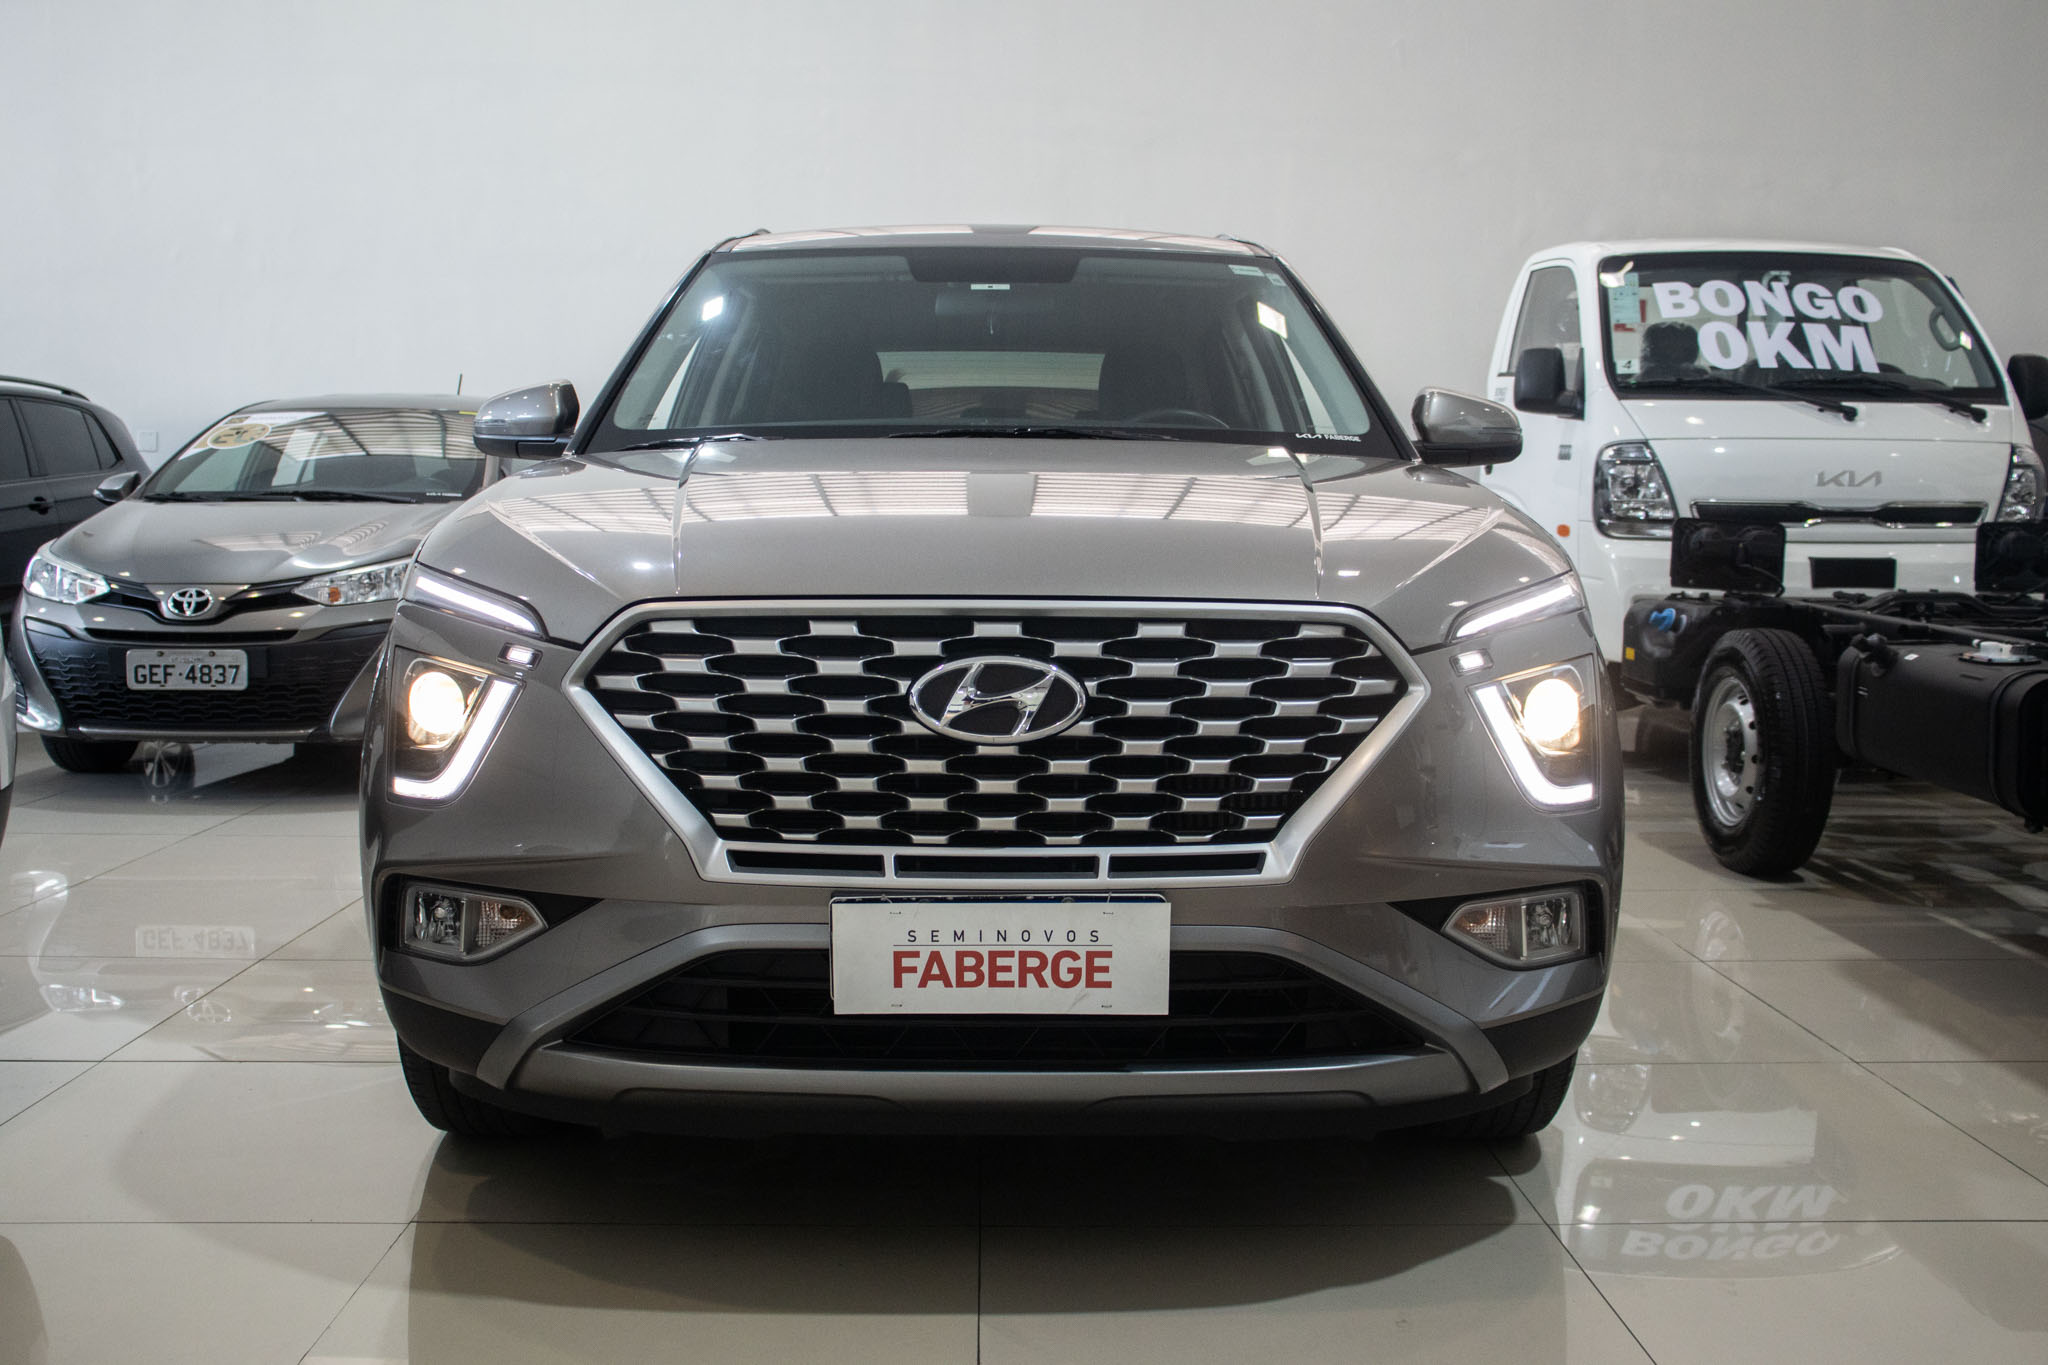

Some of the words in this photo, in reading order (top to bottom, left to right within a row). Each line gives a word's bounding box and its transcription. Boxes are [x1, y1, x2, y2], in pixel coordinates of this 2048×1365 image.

[1652, 280, 1883, 323] BONGO
[1816, 470, 1882, 487] KIA
[907, 929, 1100, 943] SEMINOVOS
[893, 950, 1113, 989] FABERGE
